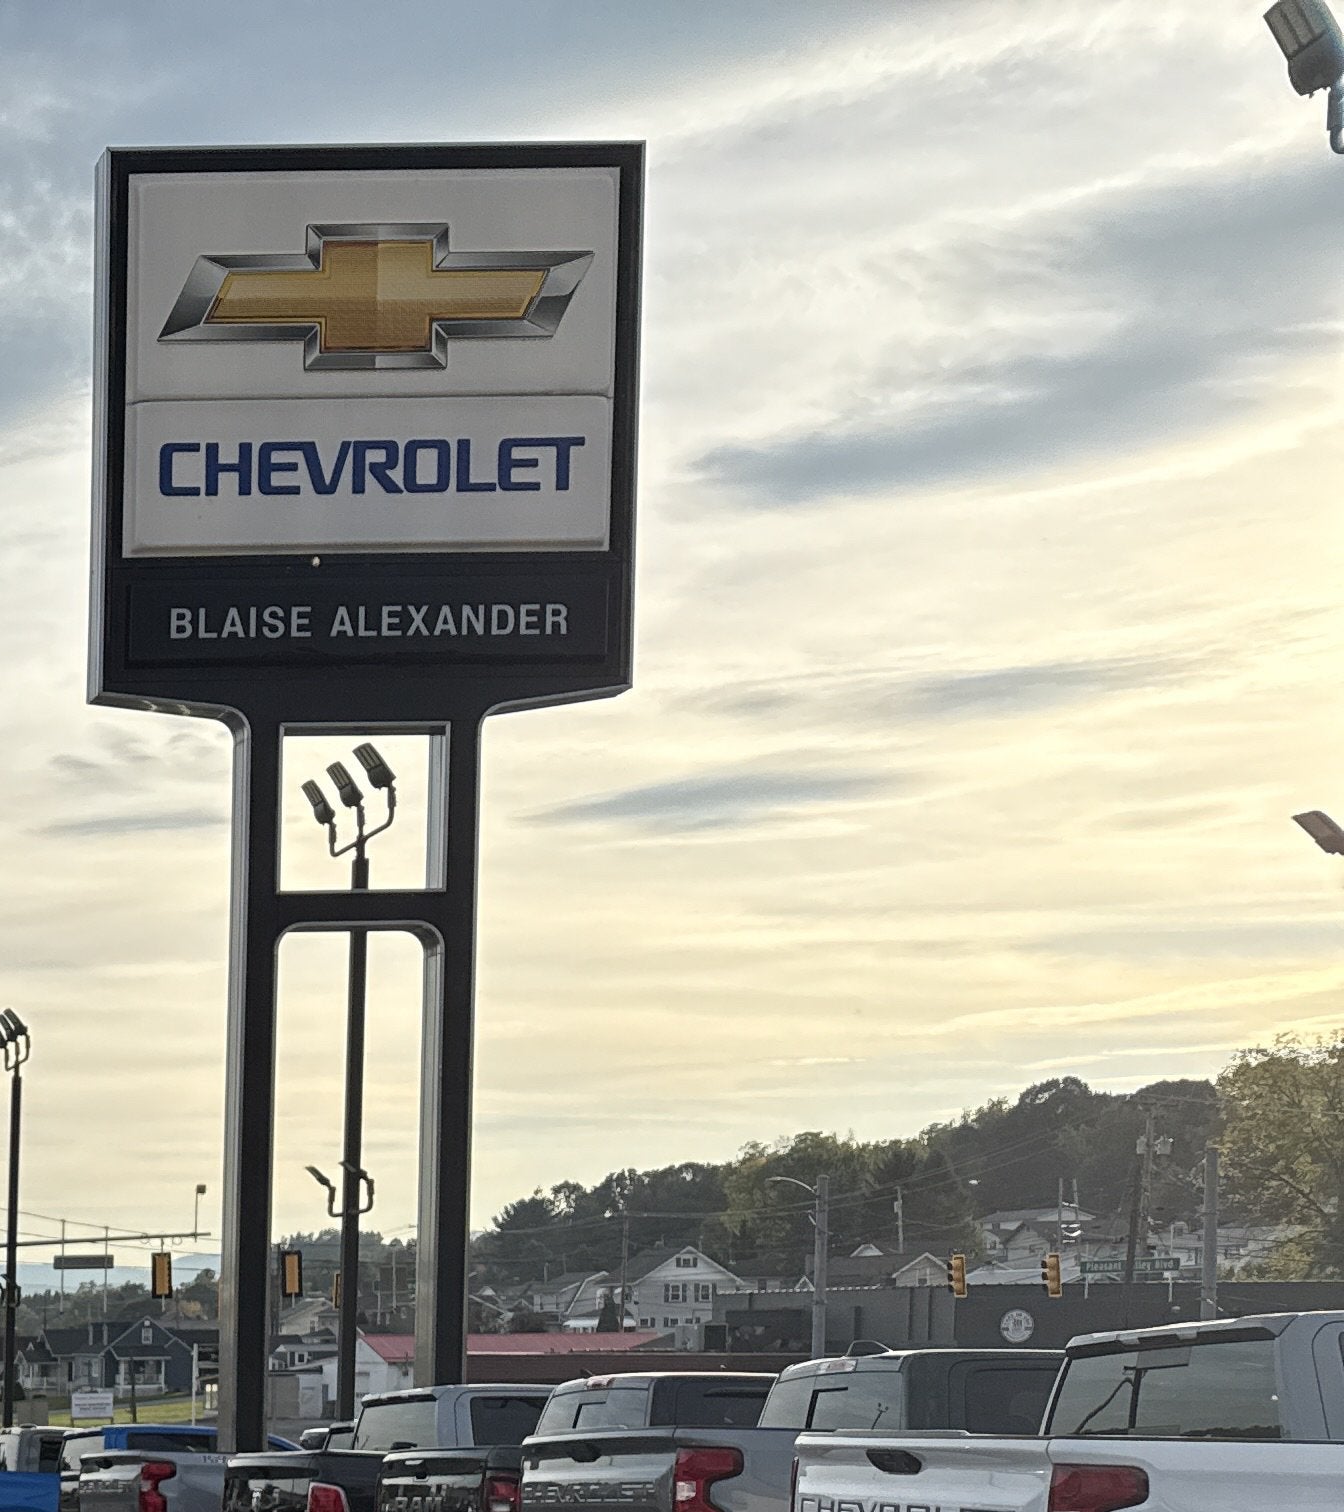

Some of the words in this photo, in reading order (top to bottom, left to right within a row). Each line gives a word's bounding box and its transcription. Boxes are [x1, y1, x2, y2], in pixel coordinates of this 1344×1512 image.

[159, 436, 586, 497] CHEVROLET
[169, 605, 313, 640] BLAISE
[329, 602, 569, 637] ALEXANDER
